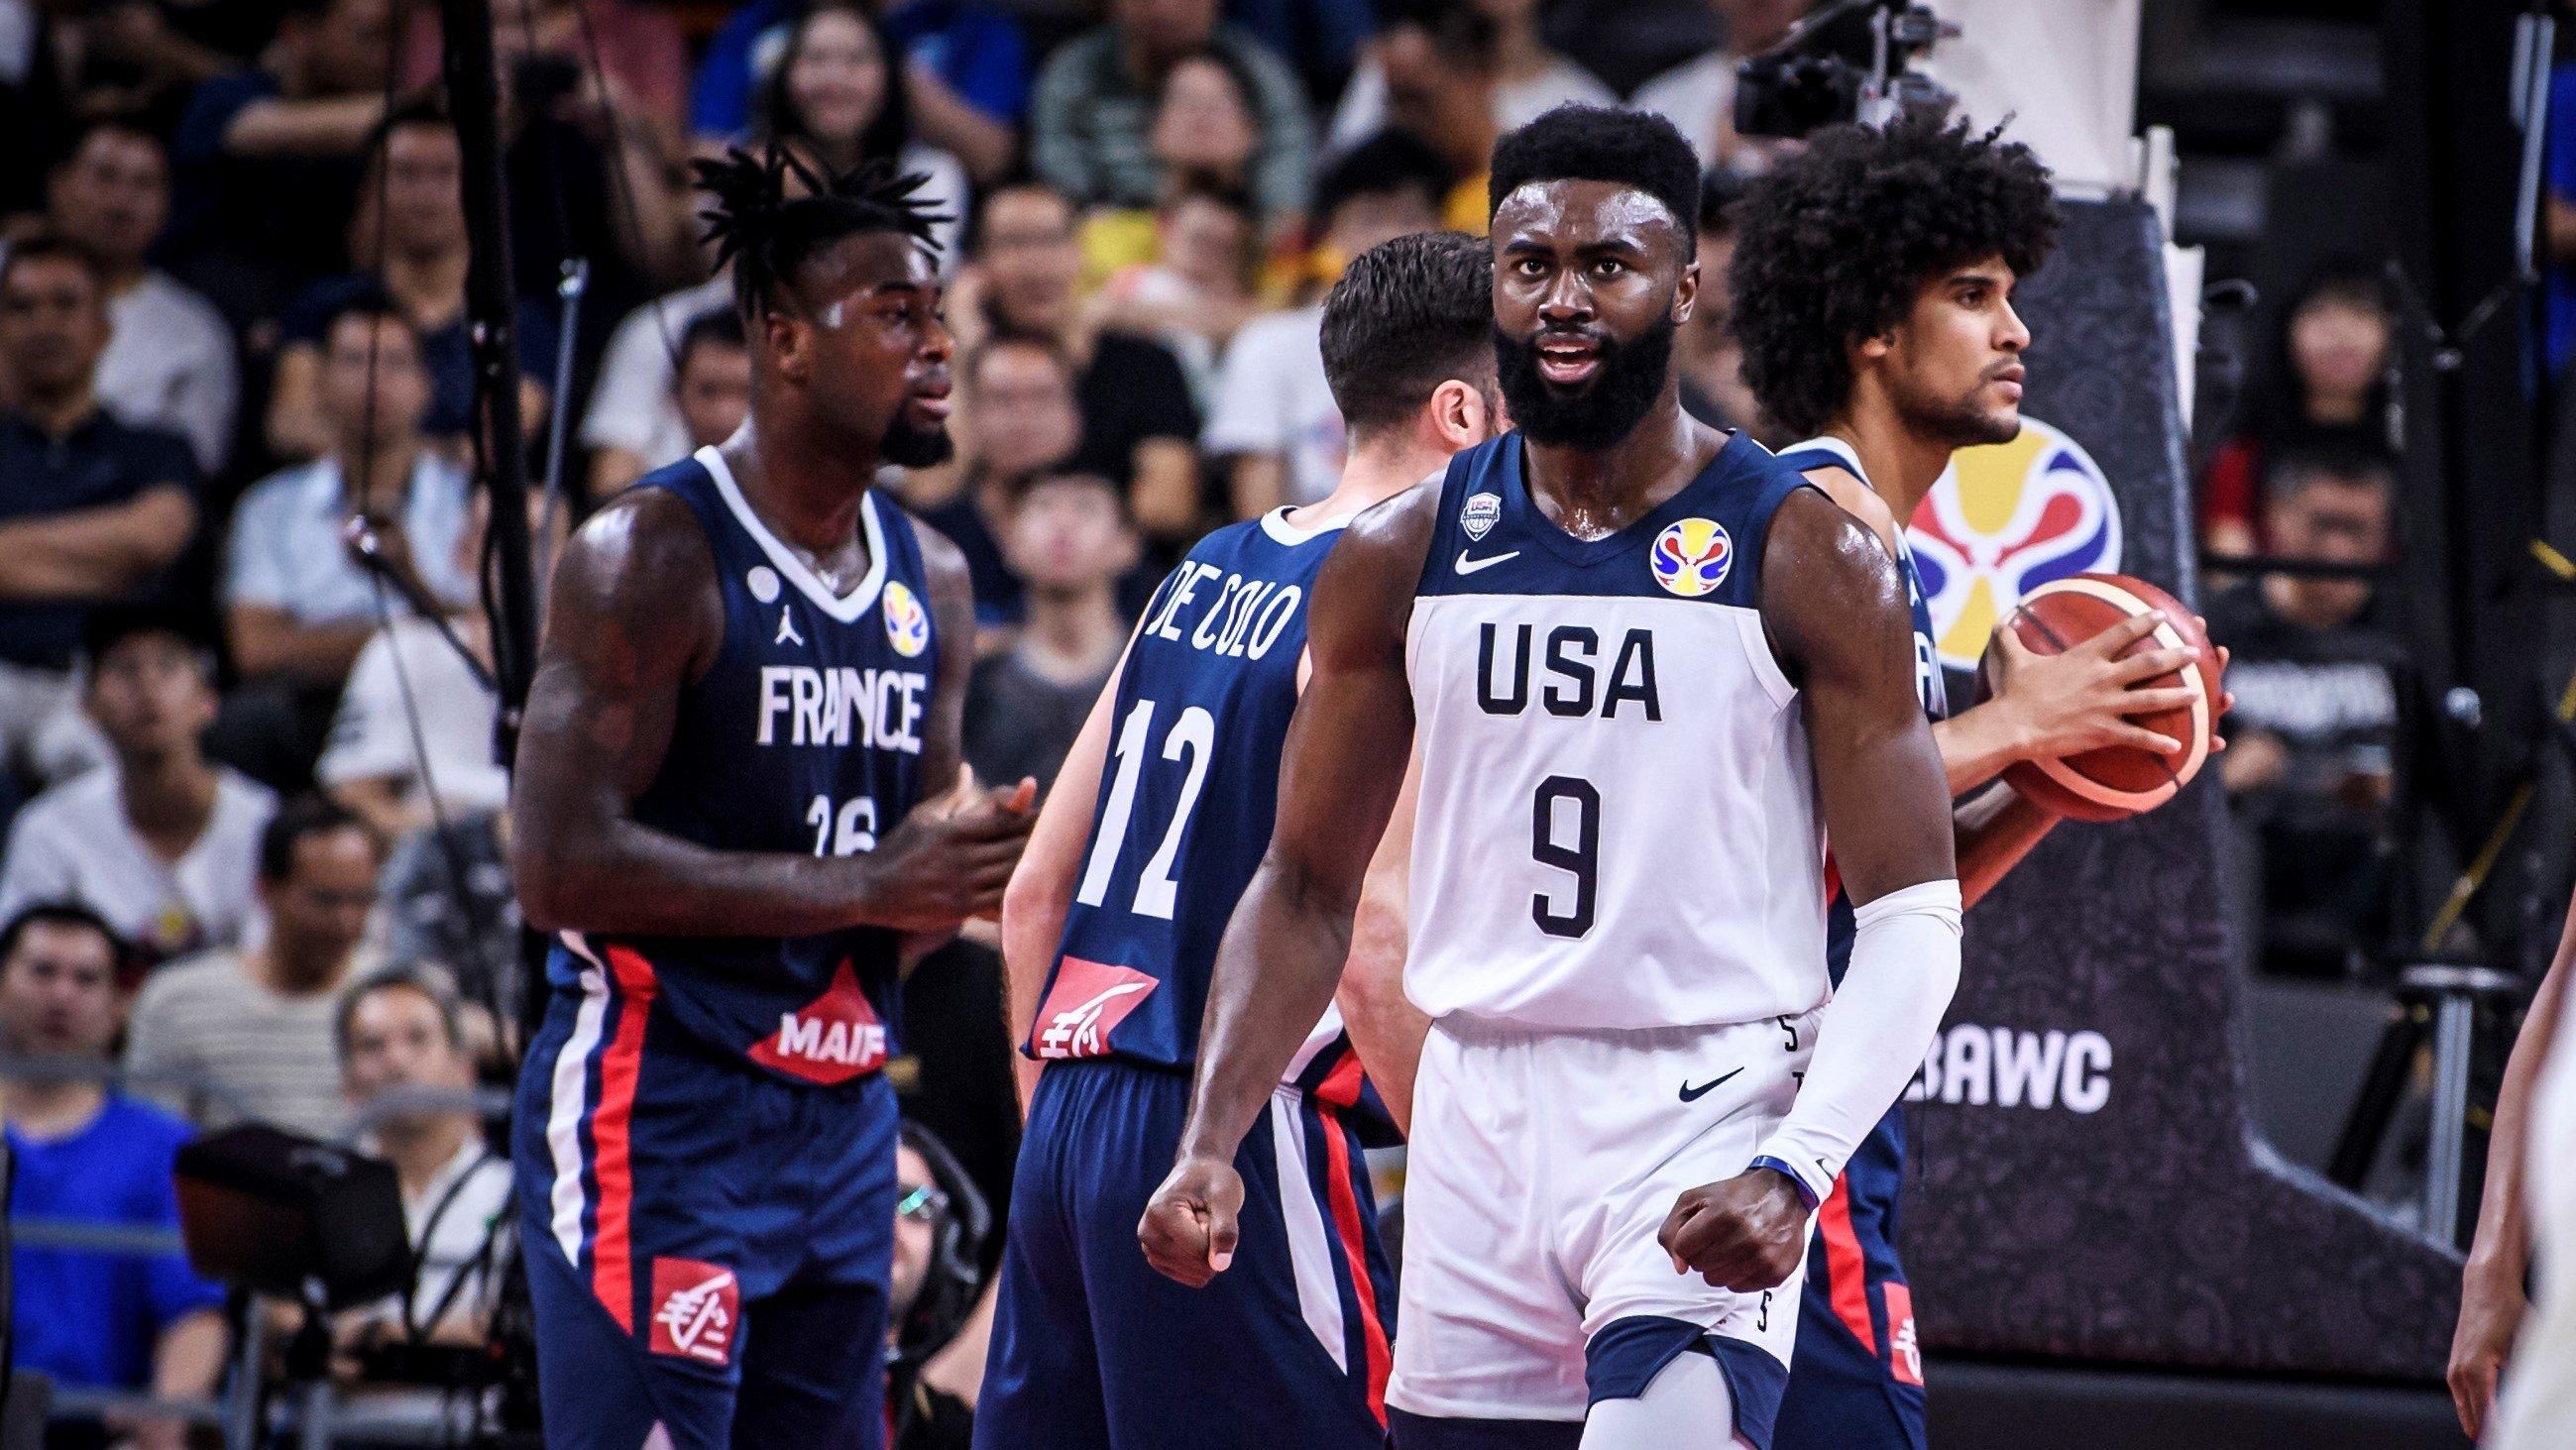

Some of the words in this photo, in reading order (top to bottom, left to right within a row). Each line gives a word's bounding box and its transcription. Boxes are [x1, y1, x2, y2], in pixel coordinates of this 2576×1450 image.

[1145, 560, 1223, 641] DE
[1191, 573, 1302, 661] COLO
[757, 665, 927, 755] FRANCE
[1477, 622, 1663, 722] USA
[1076, 699, 1215, 920] 12
[1532, 775, 1601, 939] 9
[777, 1012, 885, 1067] MAIF
